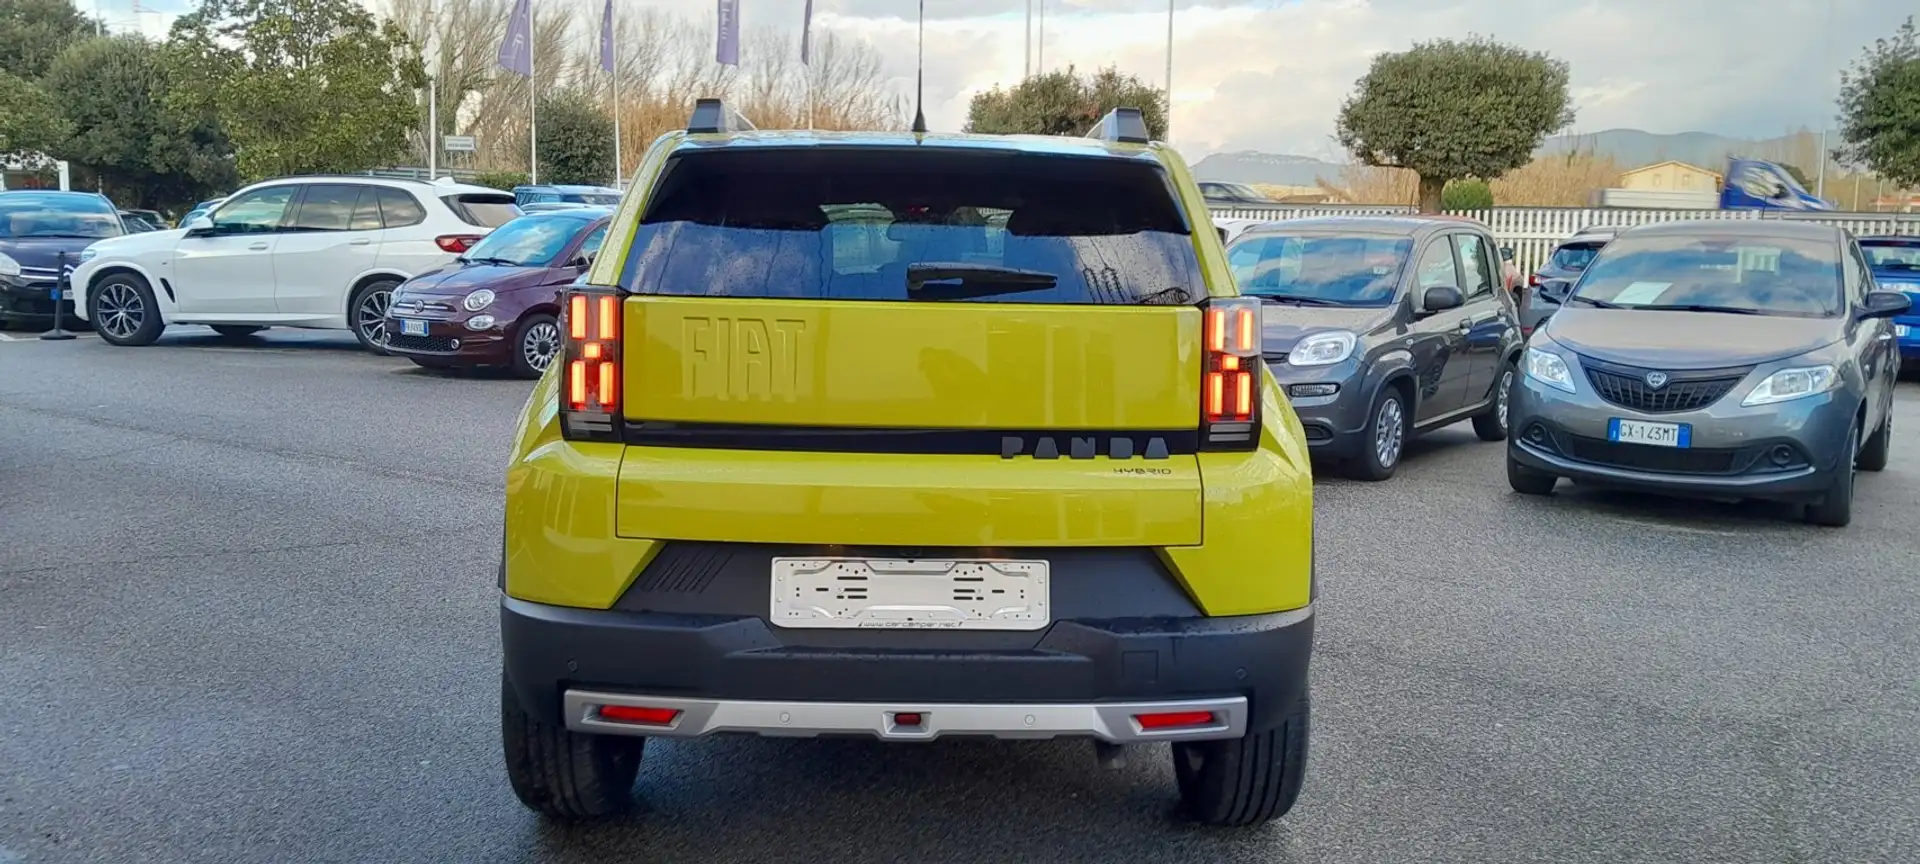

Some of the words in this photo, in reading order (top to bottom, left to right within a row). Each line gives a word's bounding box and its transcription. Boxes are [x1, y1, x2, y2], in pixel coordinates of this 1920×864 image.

[683, 316, 805, 401] FIAT
[1001, 436, 1169, 459] PANDA
[1113, 467, 1171, 475] HYBRID
